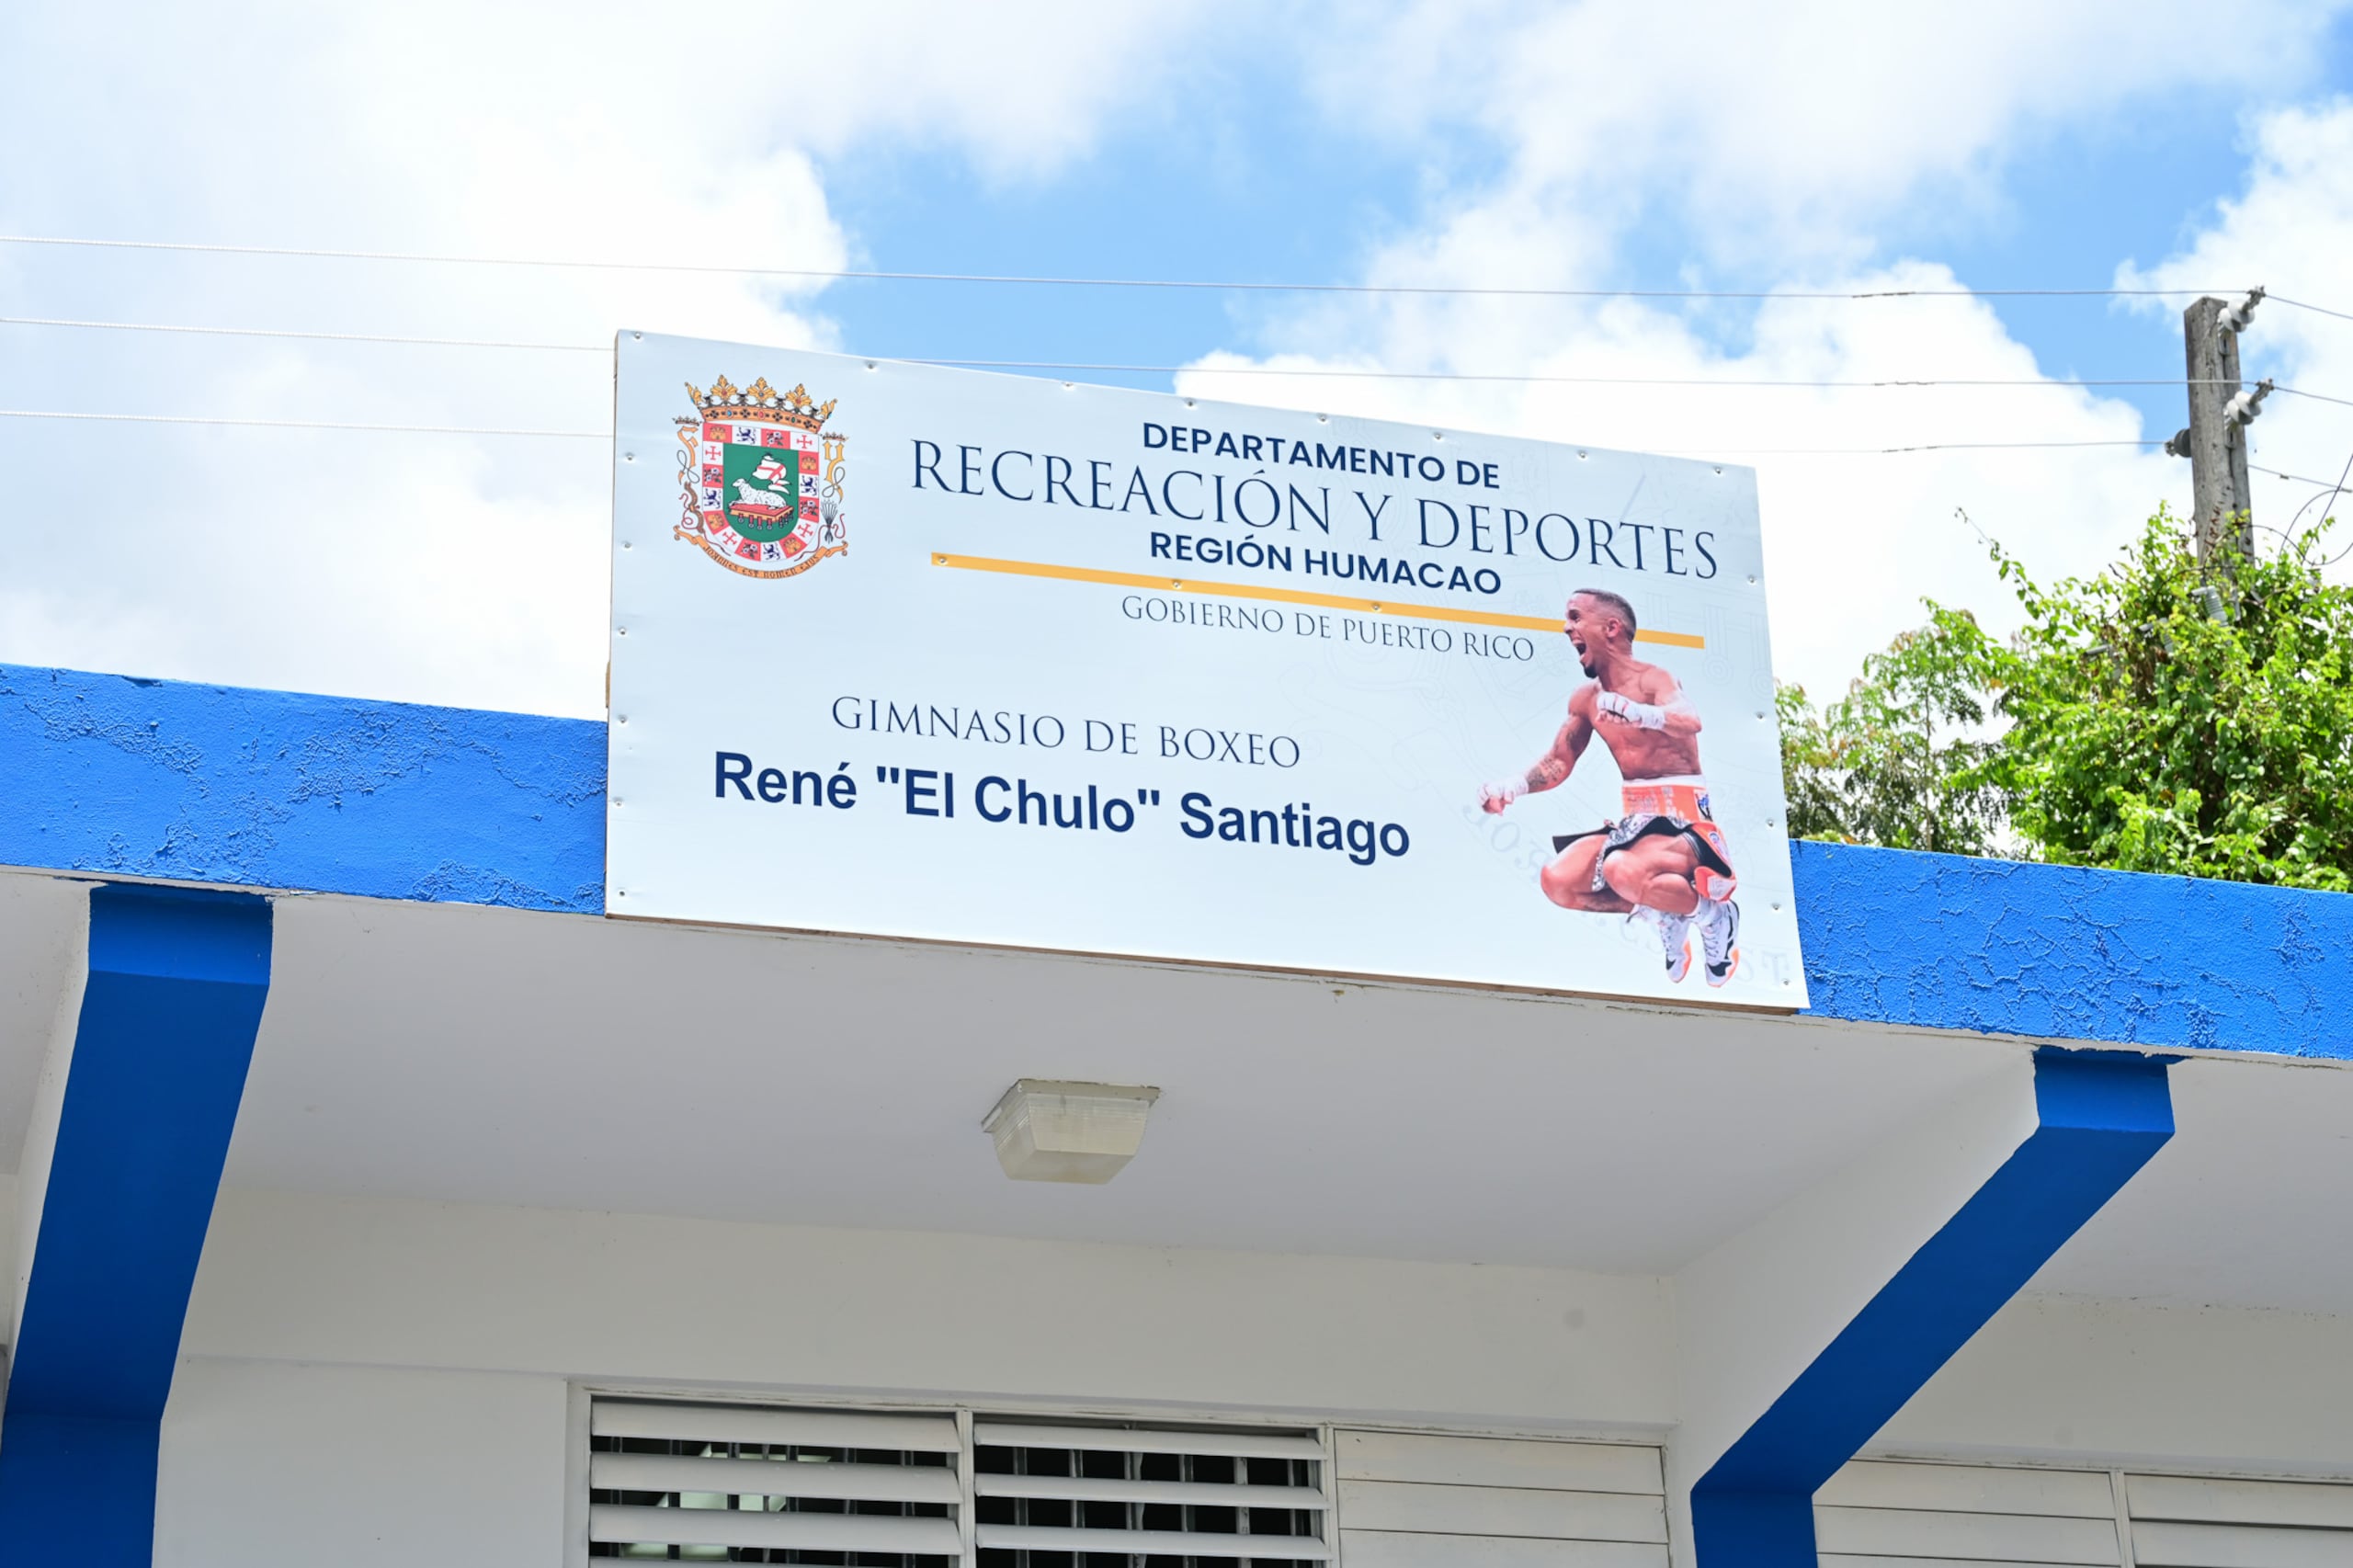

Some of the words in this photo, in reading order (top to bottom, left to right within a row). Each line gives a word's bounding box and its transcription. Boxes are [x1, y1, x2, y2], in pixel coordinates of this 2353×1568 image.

[1142, 422, 1446, 483] DEPARTAMENTO
[1456, 460, 1500, 490] DE
[911, 439, 1332, 535] RECREACIÓN
[1351, 491, 1392, 541] Y
[1415, 498, 1718, 580] DEPORTES
[1149, 531, 1292, 573] REGIÓN
[1304, 548, 1501, 598] HUMACAO
[1121, 597, 1284, 637] GOBIERNO
[1294, 612, 1332, 639] DE
[1342, 618, 1452, 653] PUERTO
[1462, 631, 1535, 662] RICO
[832, 696, 1065, 748] GIMNASIO
[1084, 720, 1139, 755] DE
[1159, 725, 1300, 768] BOXEO
[715, 750, 858, 810] René
[876, 765, 954, 819] "El
[974, 775, 1160, 833] Chulo"
[1179, 791, 1410, 866] Santiago
